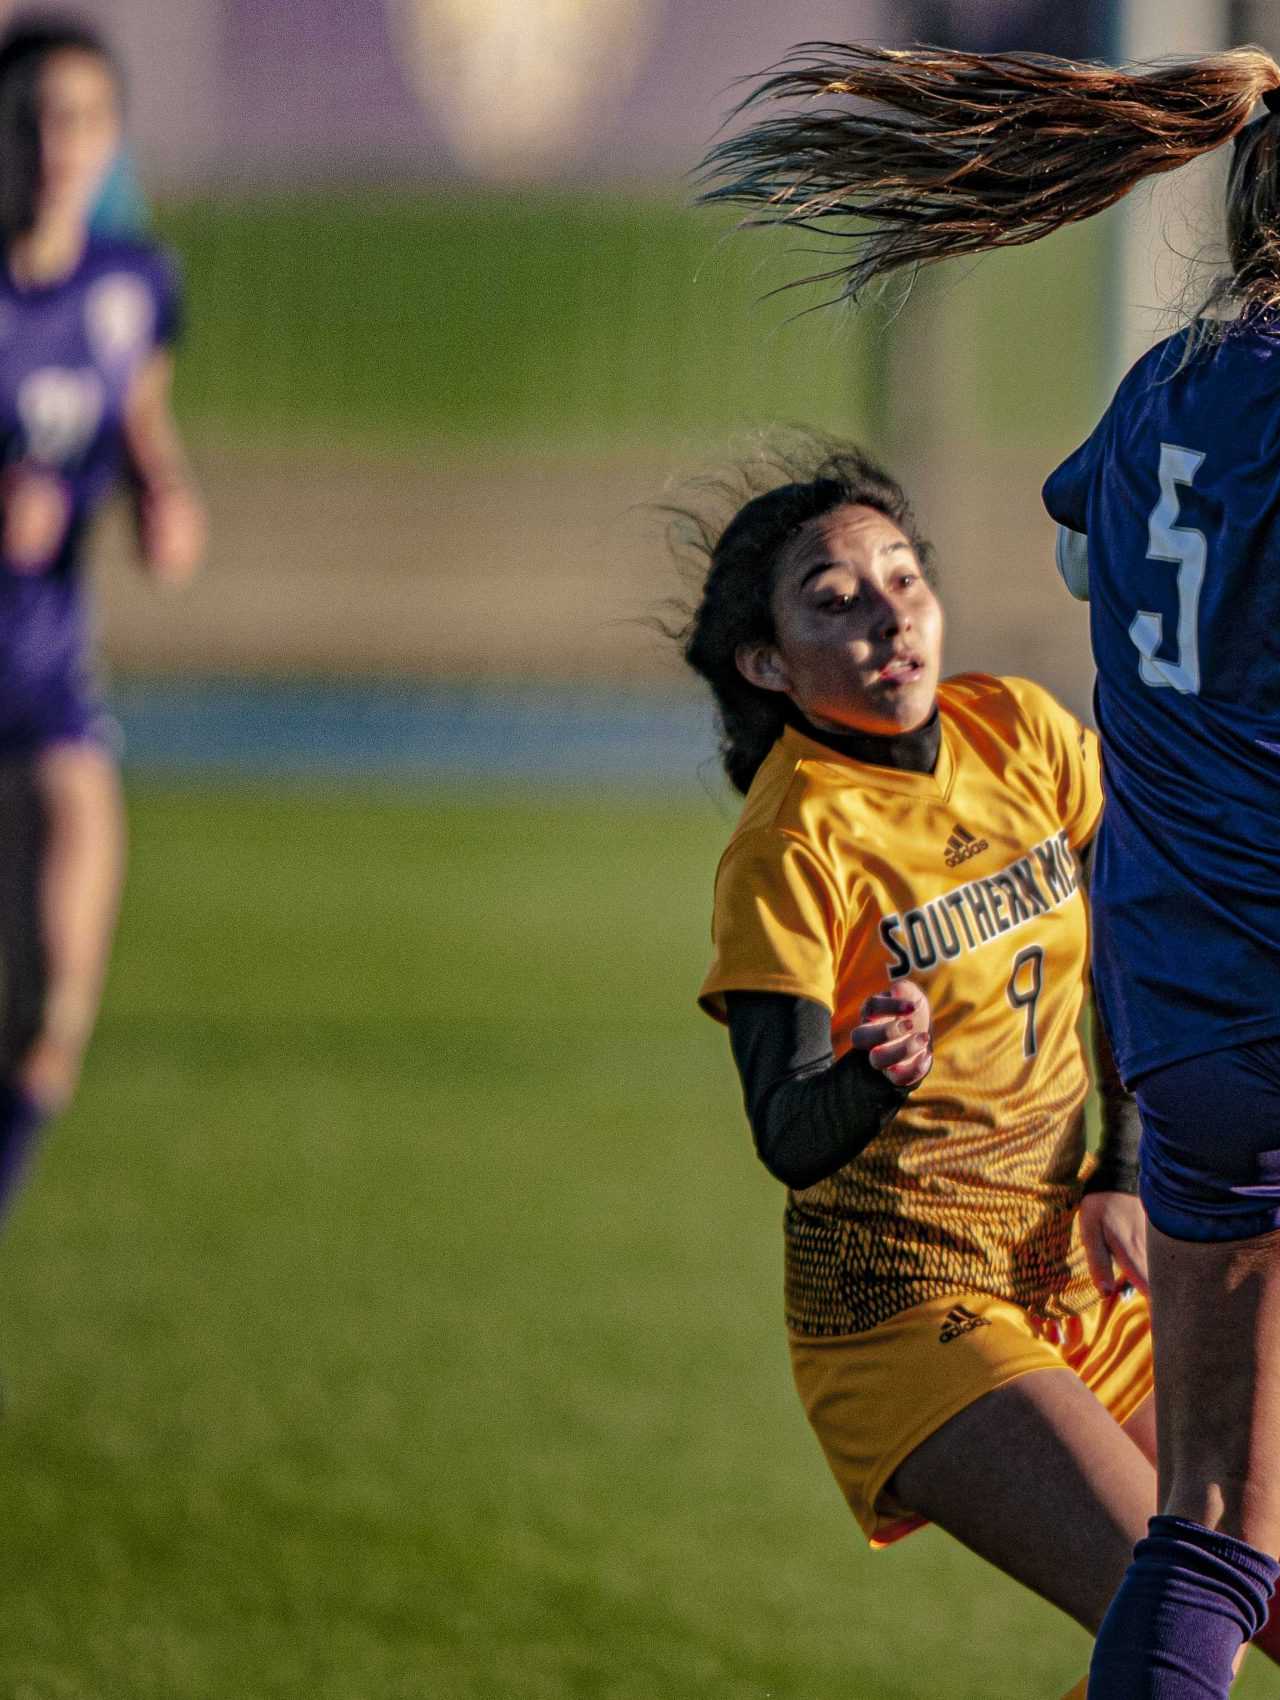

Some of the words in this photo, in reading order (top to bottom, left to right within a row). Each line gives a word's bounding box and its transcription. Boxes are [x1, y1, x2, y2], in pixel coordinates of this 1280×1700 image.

[1128, 442, 1207, 696] 5
[944, 838, 989, 868] adidas
[879, 856, 1051, 980] SOUTHERN
[1006, 943, 1043, 1057] 9
